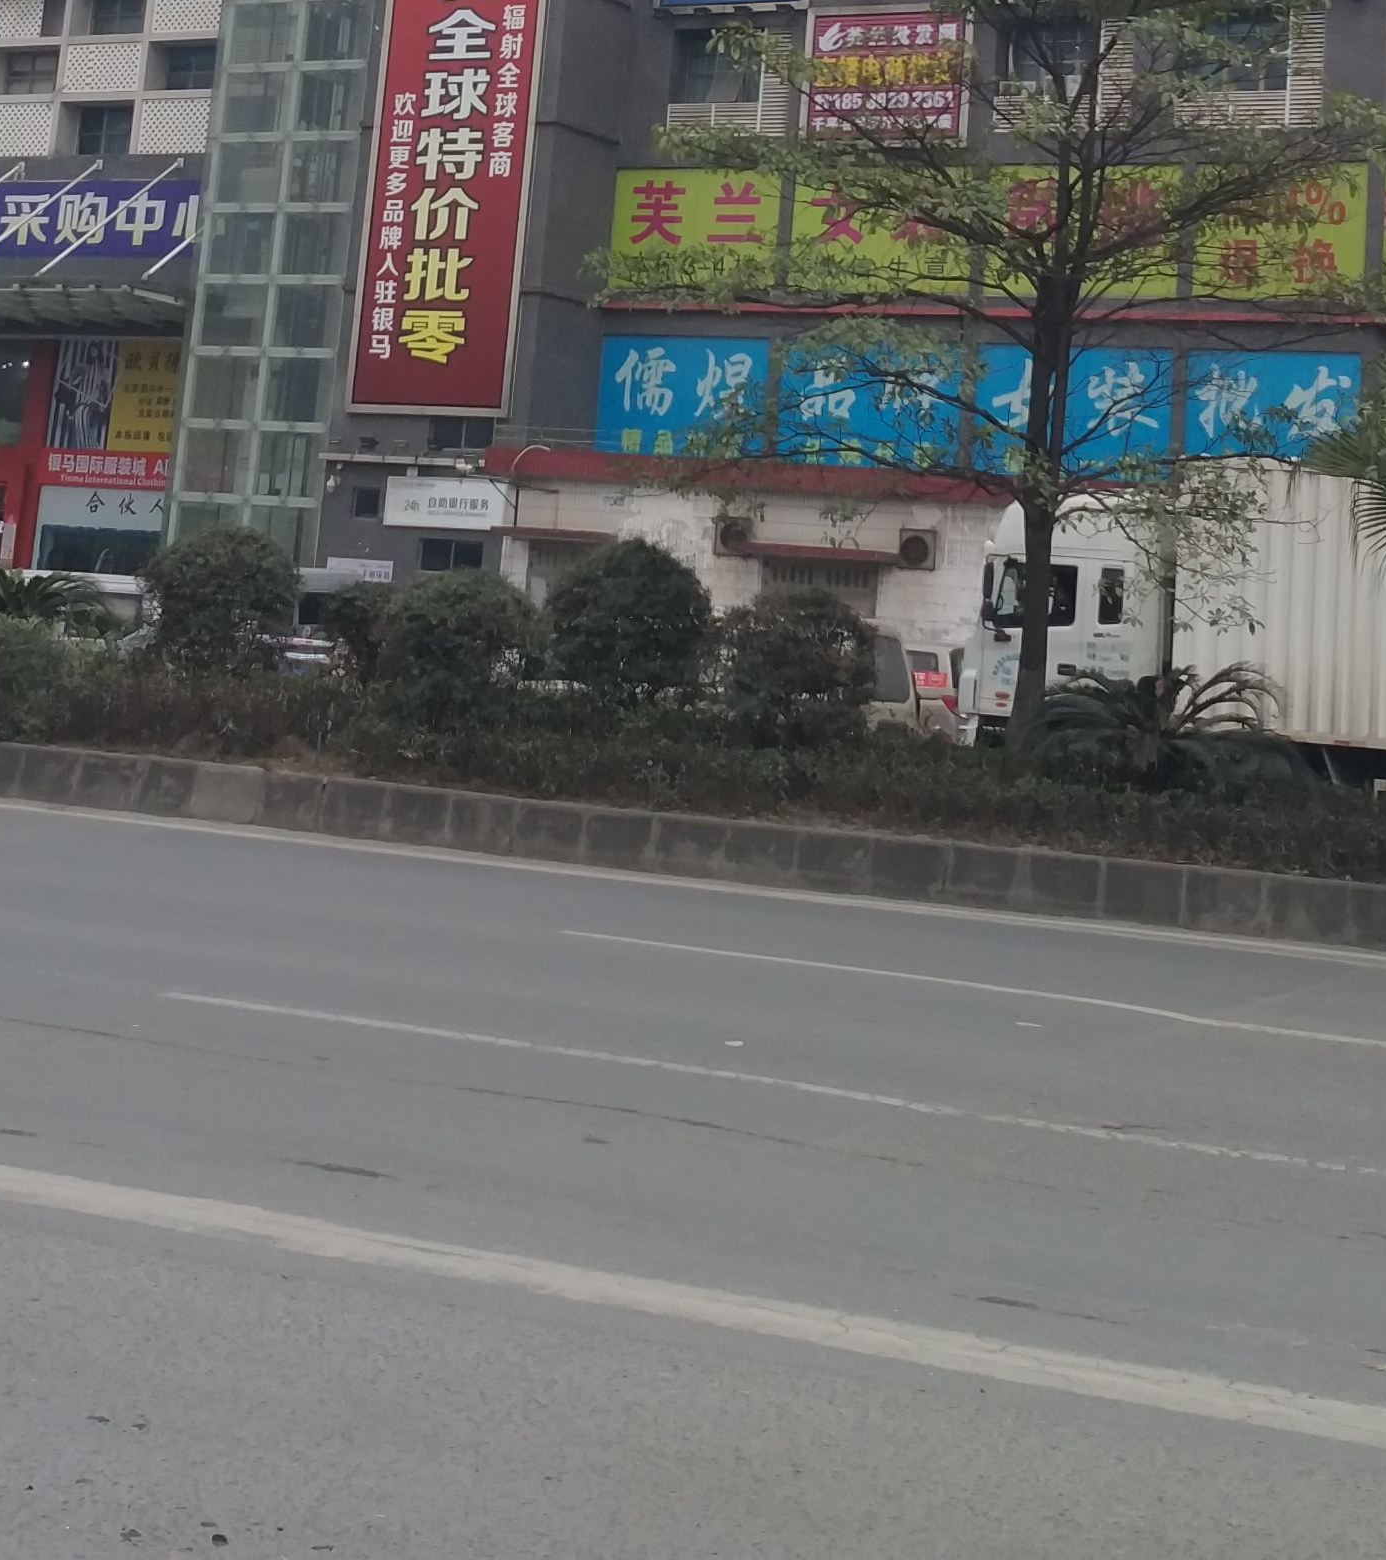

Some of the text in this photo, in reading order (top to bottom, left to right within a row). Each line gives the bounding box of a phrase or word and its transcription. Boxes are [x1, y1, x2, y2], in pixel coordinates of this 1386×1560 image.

[488, 4, 527, 178] 辐射全球客商
[47, 452, 147, 477] 银马国际服装城
[85, 490, 164, 515] 合伙人
